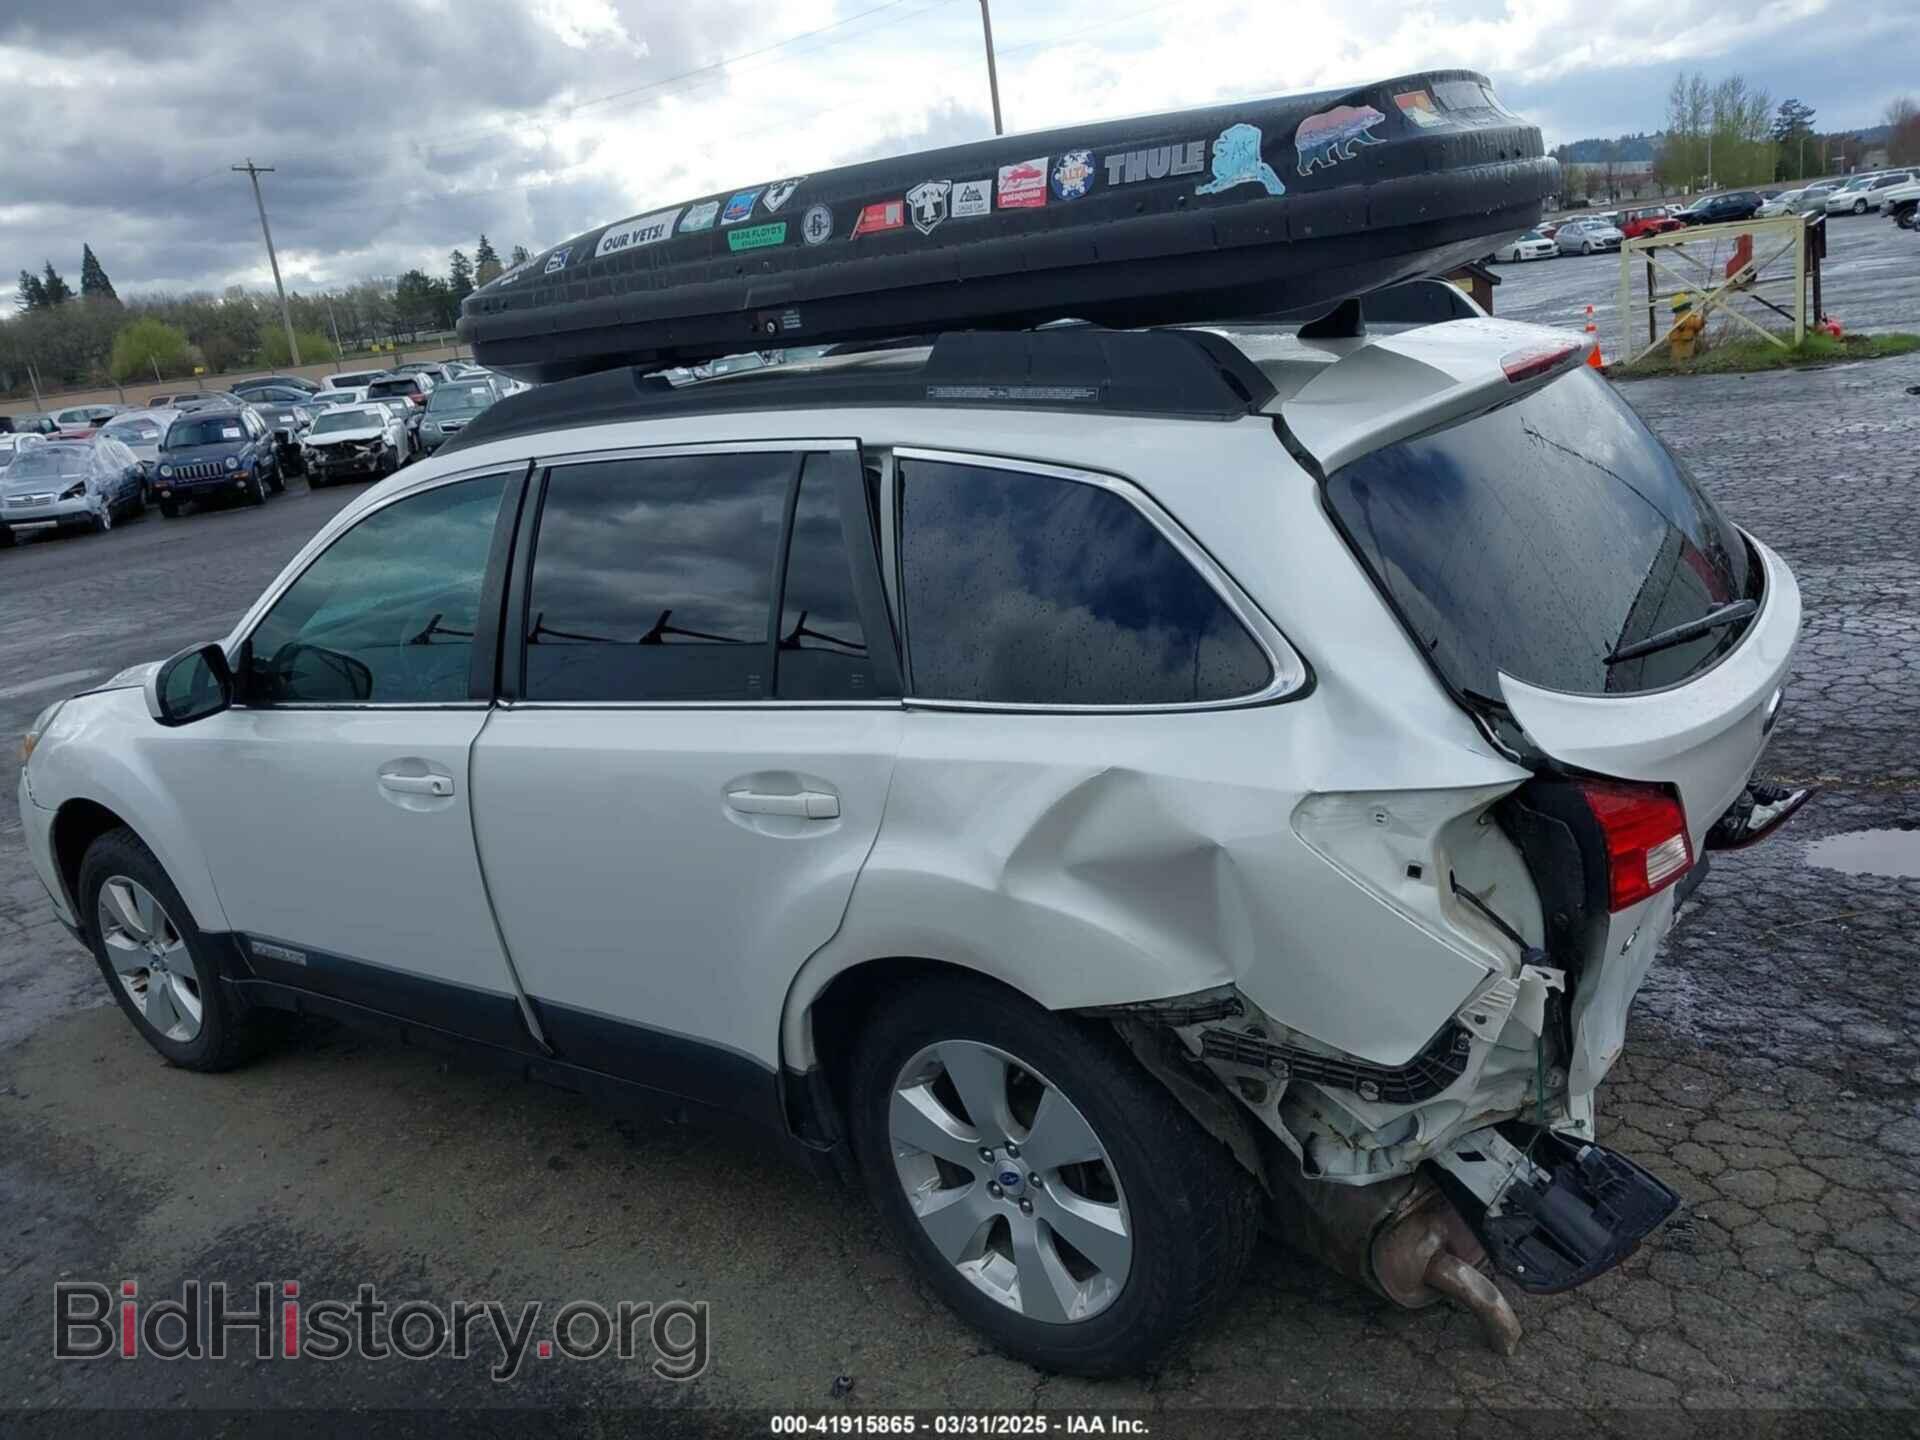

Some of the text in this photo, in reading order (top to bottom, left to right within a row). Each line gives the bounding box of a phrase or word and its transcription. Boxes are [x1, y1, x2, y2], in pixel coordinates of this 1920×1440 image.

[1104, 140, 1206, 186] THULE
[603, 224, 665, 252] OUR VETS!
